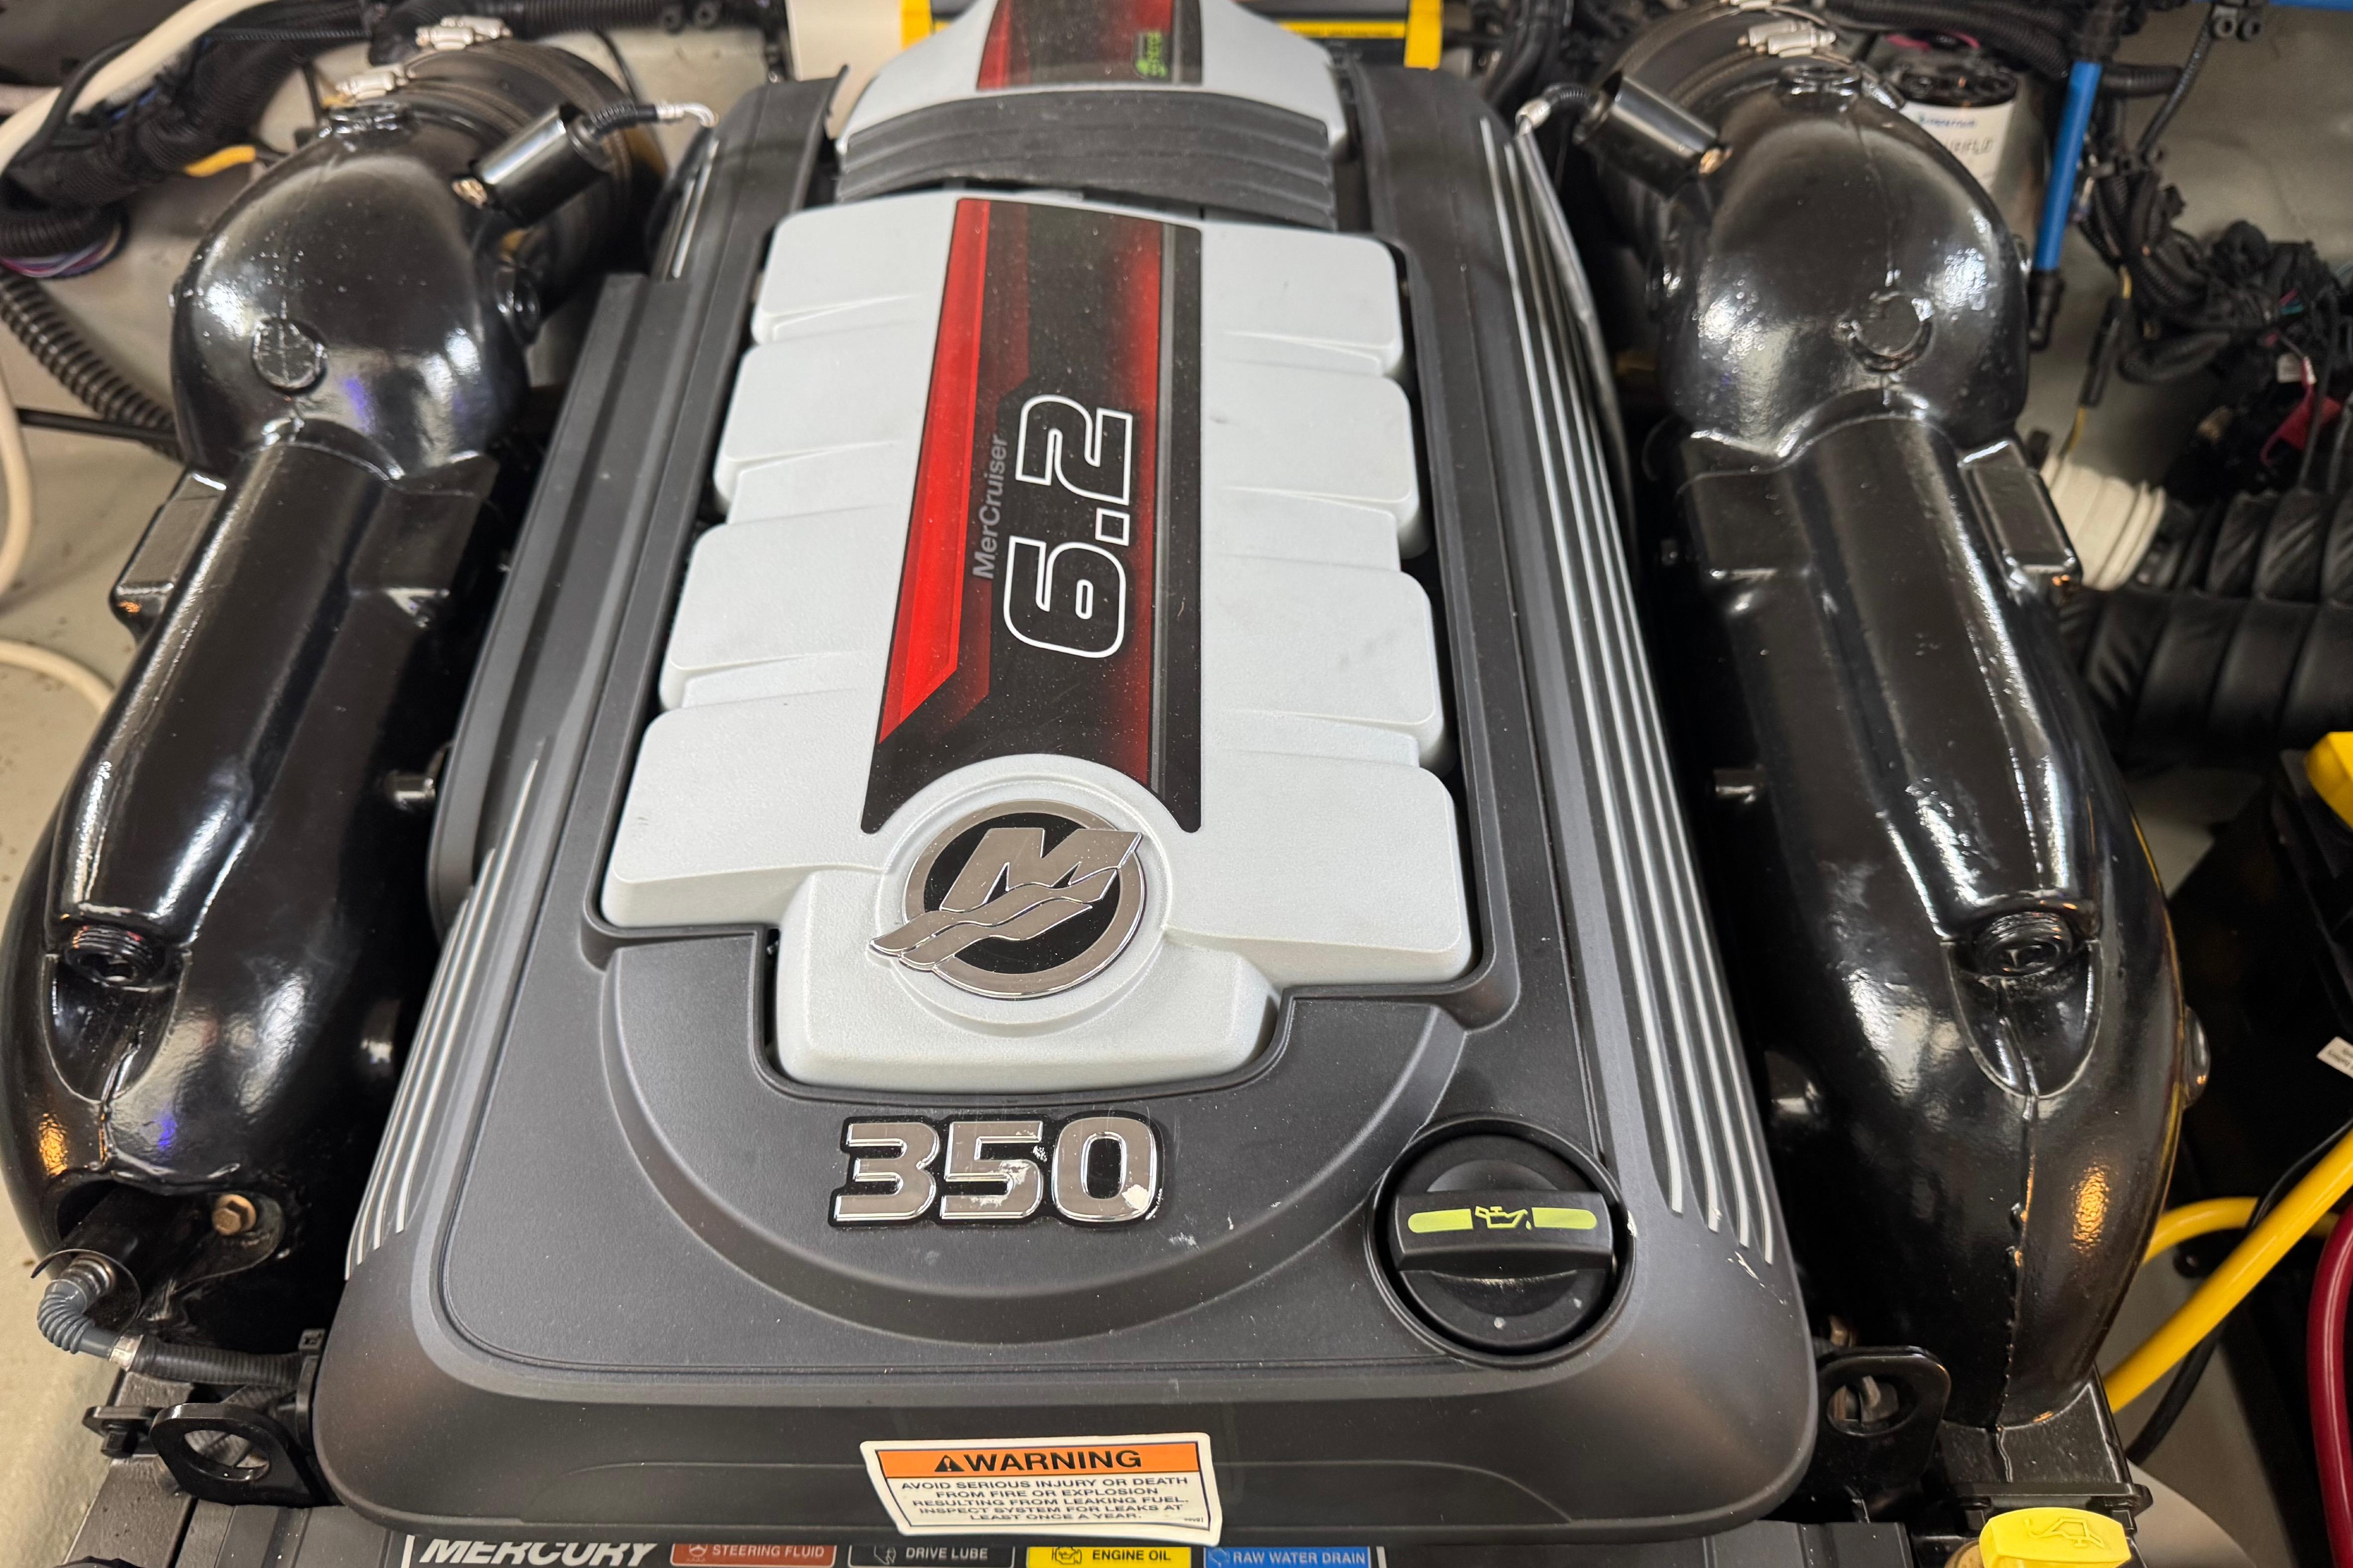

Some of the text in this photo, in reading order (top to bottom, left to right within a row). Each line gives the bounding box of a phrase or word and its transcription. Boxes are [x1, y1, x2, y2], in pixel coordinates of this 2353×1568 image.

[972, 434, 1008, 579] MerCruiser
[1003, 393, 1133, 659] 6.2
[834, 1116, 1158, 1223] 350
[963, 1449, 1142, 1471] WARNING
[956, 1480, 1031, 1489] SERIOUS
[1035, 1478, 1097, 1487] INJURY
[1132, 1477, 1188, 1485] DEATH
[1061, 1487, 1158, 1496] EXPLOSION
[419, 1538, 658, 1567] MERCURY
[712, 1544, 825, 1558] STEERING FLUID
[906, 1547, 989, 1560] DRIVE LUBE
[1092, 1549, 1171, 1561] ENGINE OIL
[1233, 1551, 1366, 1565] RAW WATER DRAIN
